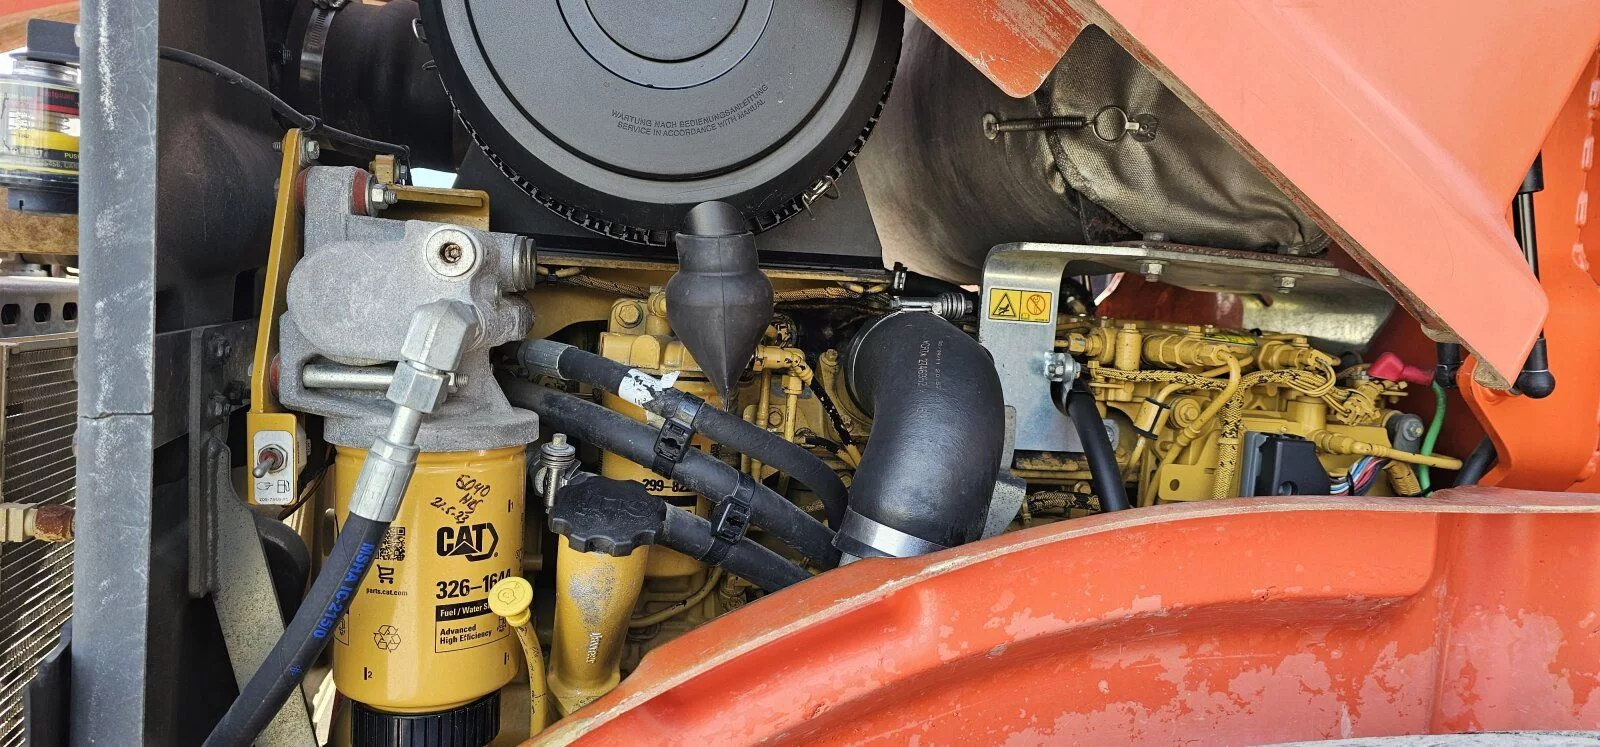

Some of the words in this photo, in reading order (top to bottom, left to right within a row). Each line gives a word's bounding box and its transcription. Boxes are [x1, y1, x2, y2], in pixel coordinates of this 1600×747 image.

[611, 109, 652, 127] WARTUNG
[654, 120, 677, 129] NACH
[679, 84, 769, 128] BEDIENUNGSANLEITUNG
[617, 121, 652, 136] SERVICE
[653, 128, 662, 137] IN
[662, 123, 717, 137] ACCORDANCE
[718, 115, 738, 129] WITH
[737, 99, 766, 121] MANUAL
[436, 522, 493, 560] CAT
[343, 542, 376, 584] MSHA
[366, 587, 408, 596] parts.cat.com
[440, 608, 456, 618] Fuel
[461, 604, 483, 615] Water
[440, 623, 477, 636] Advanced
[440, 635, 458, 645] High
[459, 629, 492, 642] Efficiency
